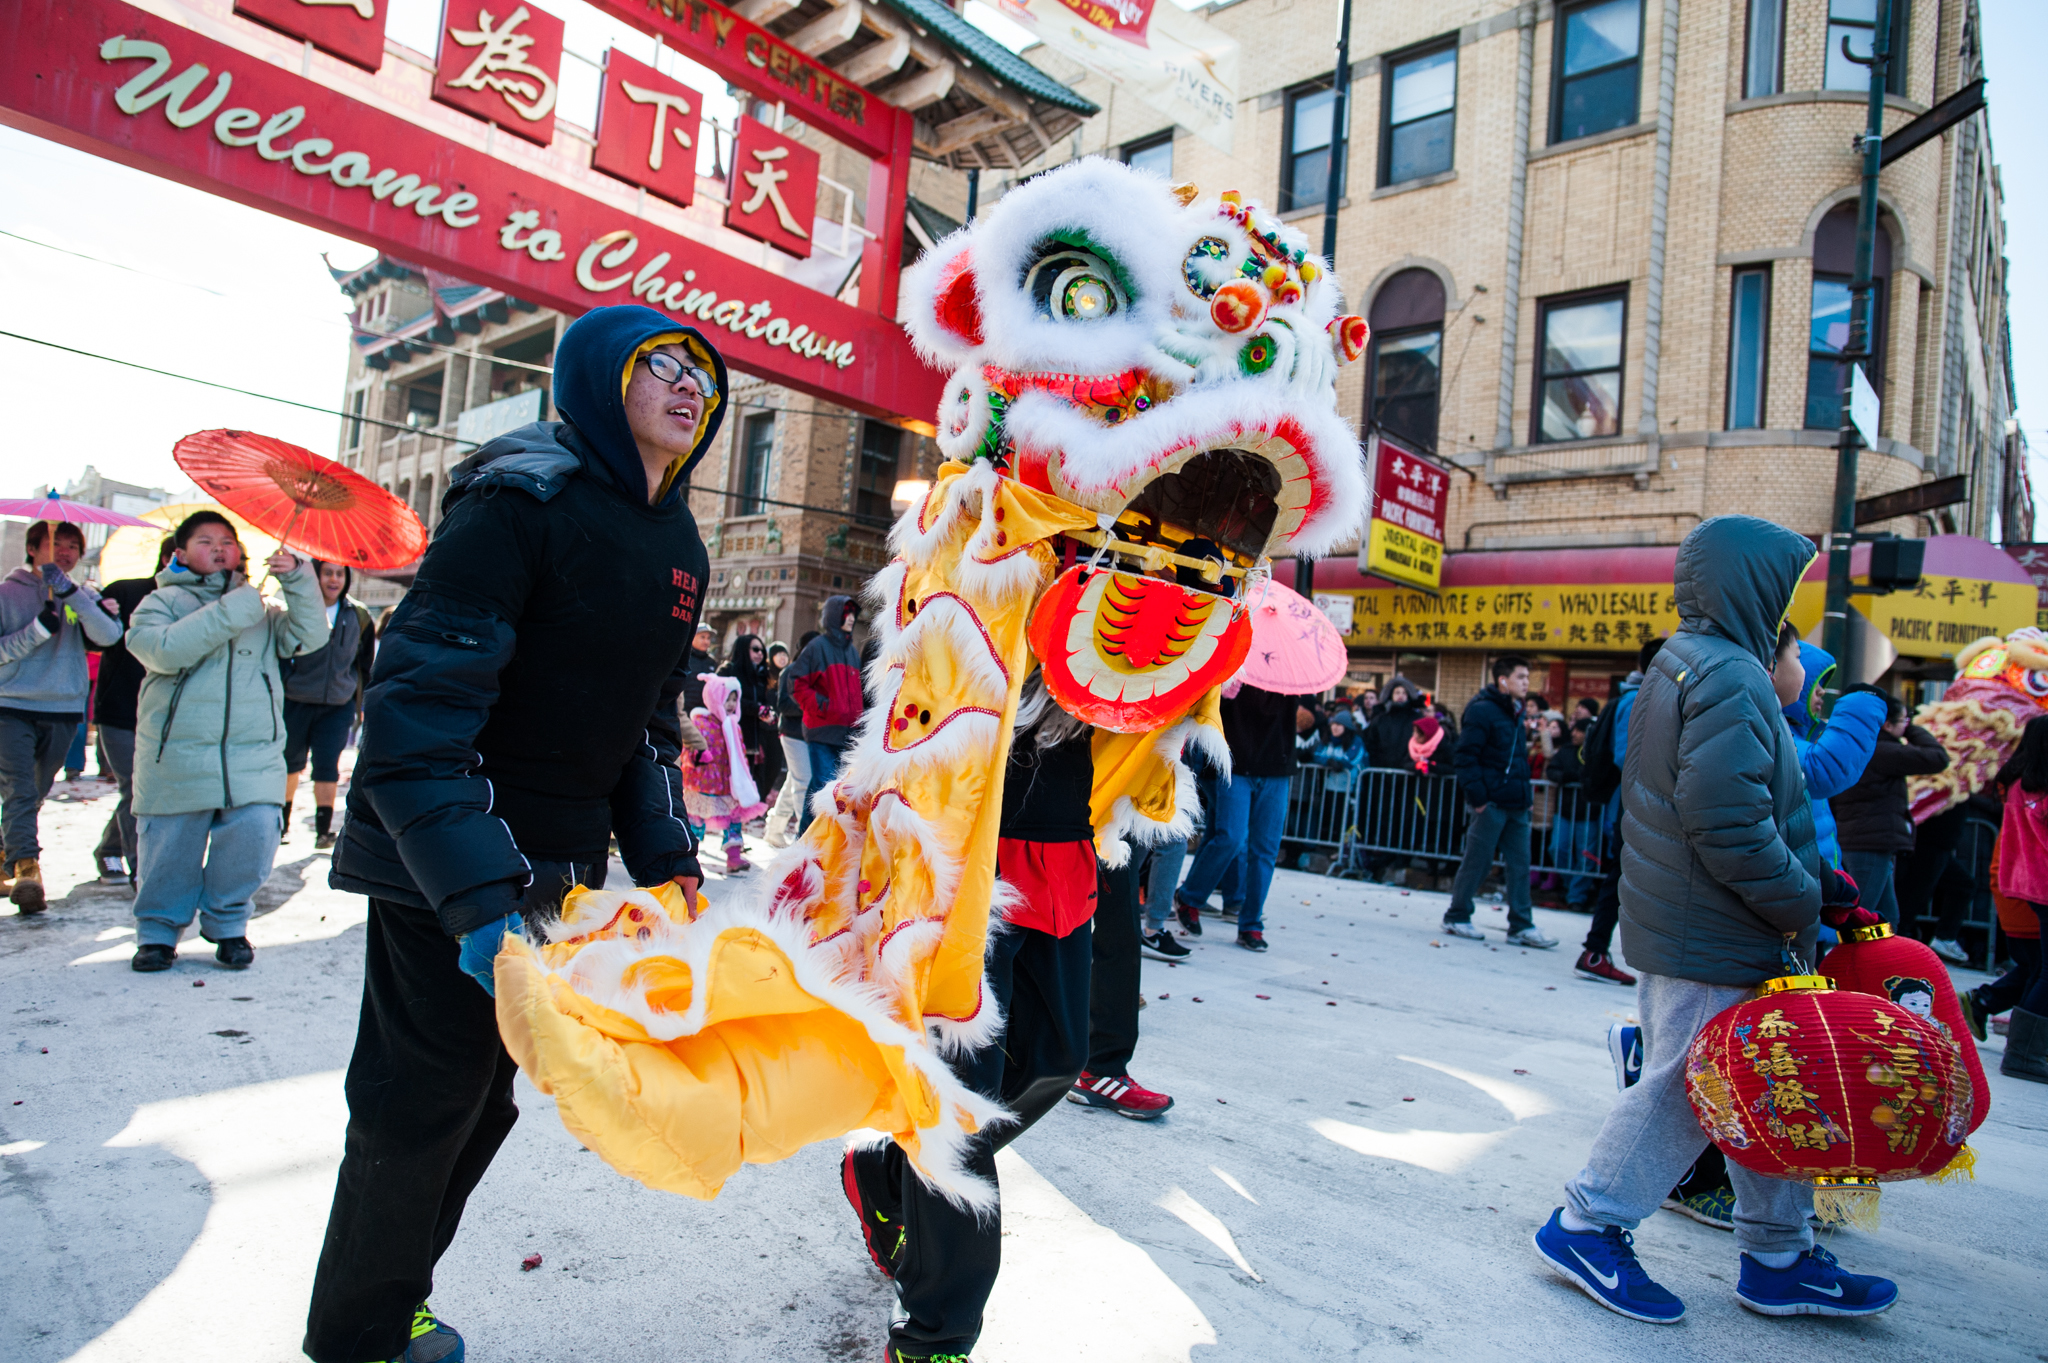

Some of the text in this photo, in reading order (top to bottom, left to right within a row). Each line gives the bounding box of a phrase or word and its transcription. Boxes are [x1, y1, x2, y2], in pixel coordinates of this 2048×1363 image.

[745, 32, 866, 126] CENTER
[101, 34, 856, 370] Welcome to Chinatown
[1391, 456, 1443, 497] 太平洋
[1393, 594, 1468, 615] FURNITURE
[1494, 592, 1532, 615] GIFTS
[1560, 591, 1659, 616] WHOLESALE
[1915, 577, 1998, 609] 太平洋
[1891, 617, 1933, 642] PACIFIC
